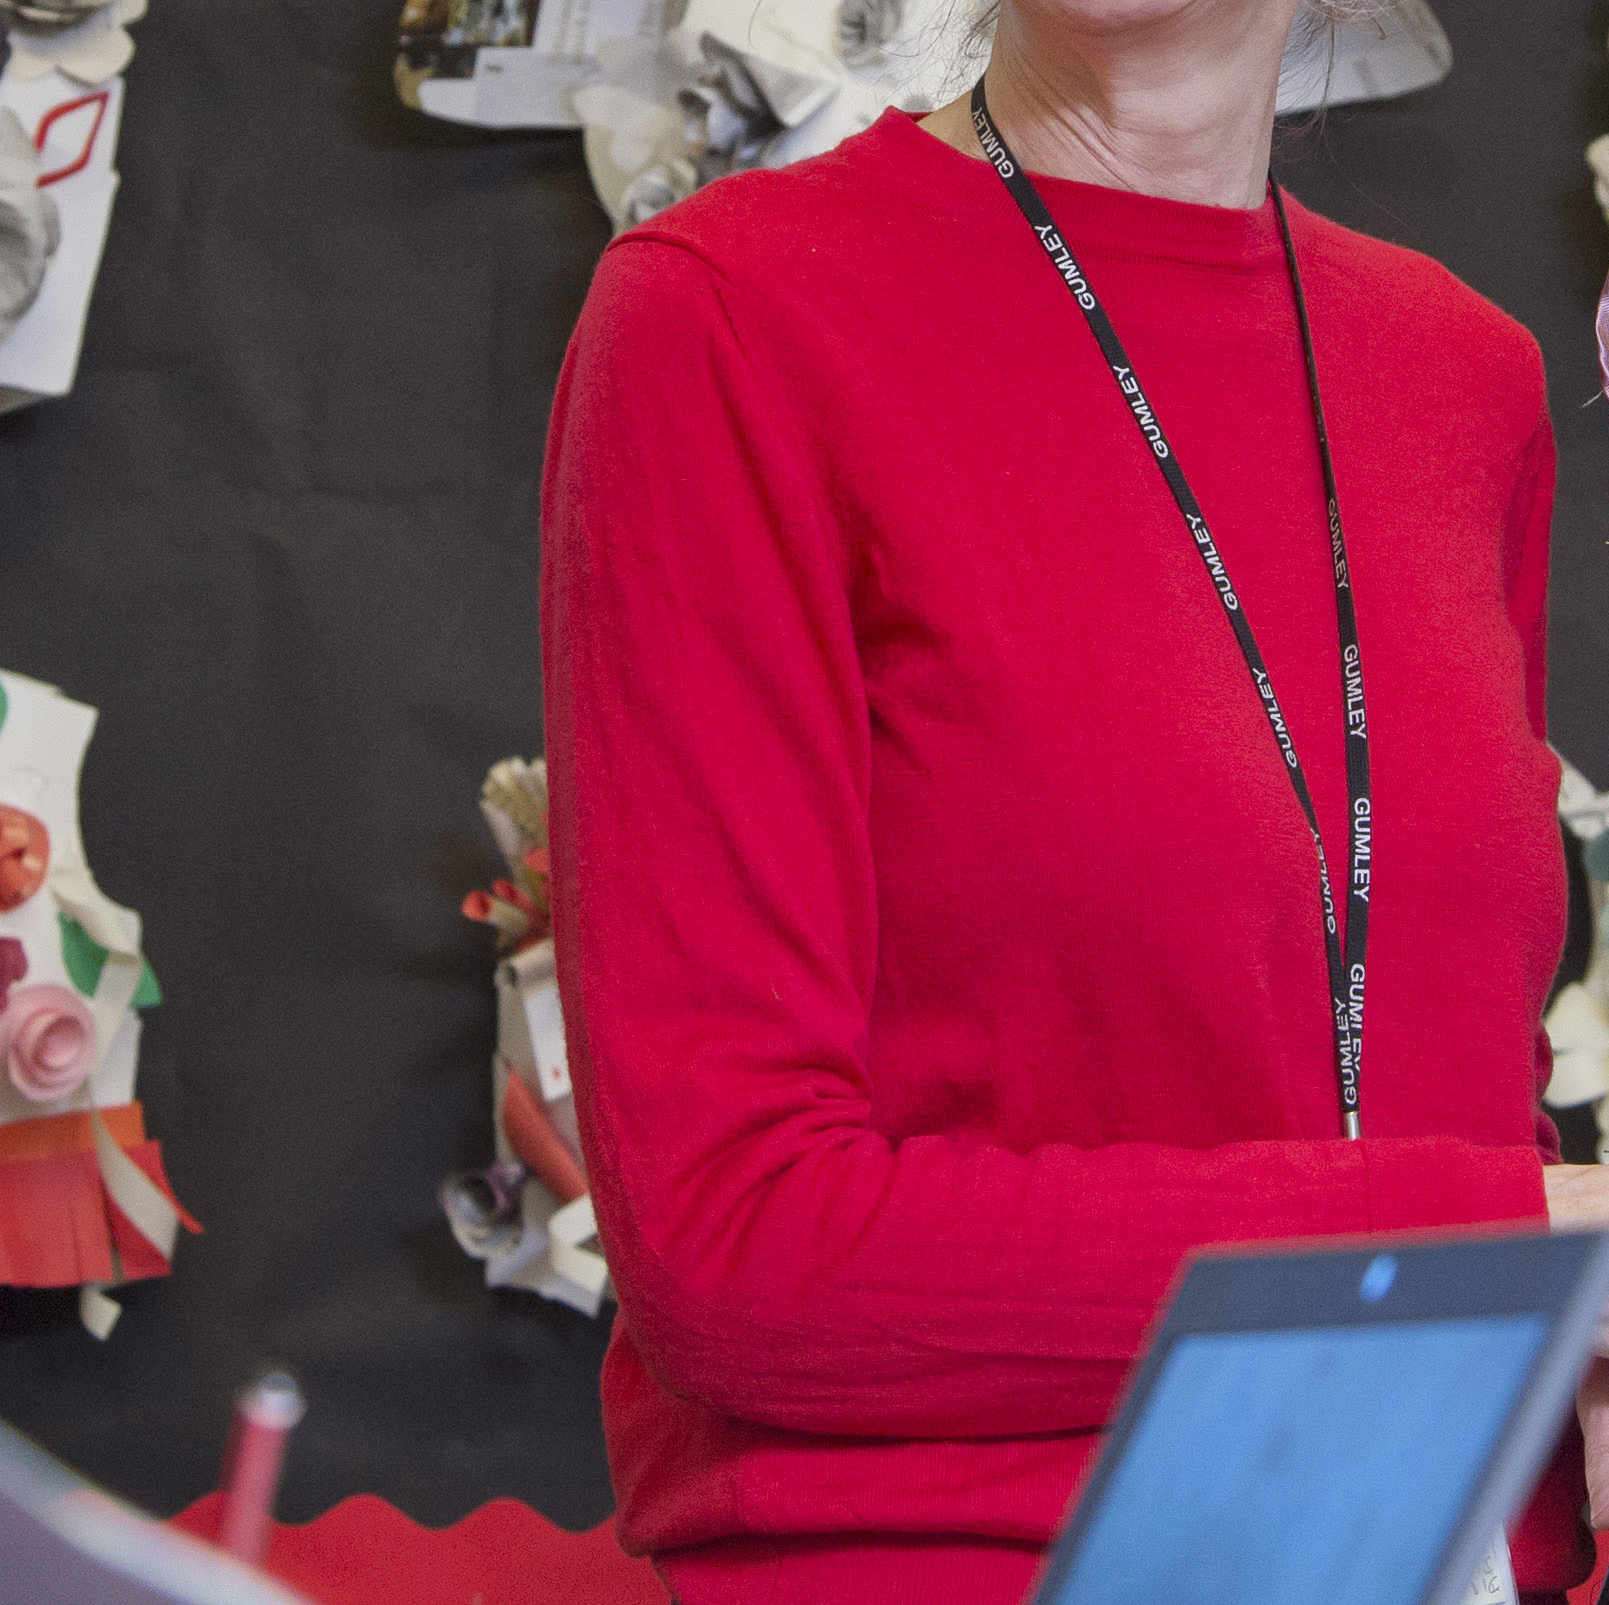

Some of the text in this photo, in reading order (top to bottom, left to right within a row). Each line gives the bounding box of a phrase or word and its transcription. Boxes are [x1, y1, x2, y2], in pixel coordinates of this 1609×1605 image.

[971, 107, 1014, 179] GUMLEY
[1034, 224, 1096, 310] GUMLEY
[1112, 365, 1169, 459] GUMLEY
[1186, 513, 1238, 611] GUMLEY
[1328, 499, 1349, 588] GUMLEY
[1252, 667, 1298, 769] GUMLEY
[1344, 644, 1367, 740] GUMLEY
[1310, 827, 1336, 935] GUMLEY
[1354, 797, 1371, 902] GUMLEY
[1334, 997, 1357, 1105] GUMLEY
